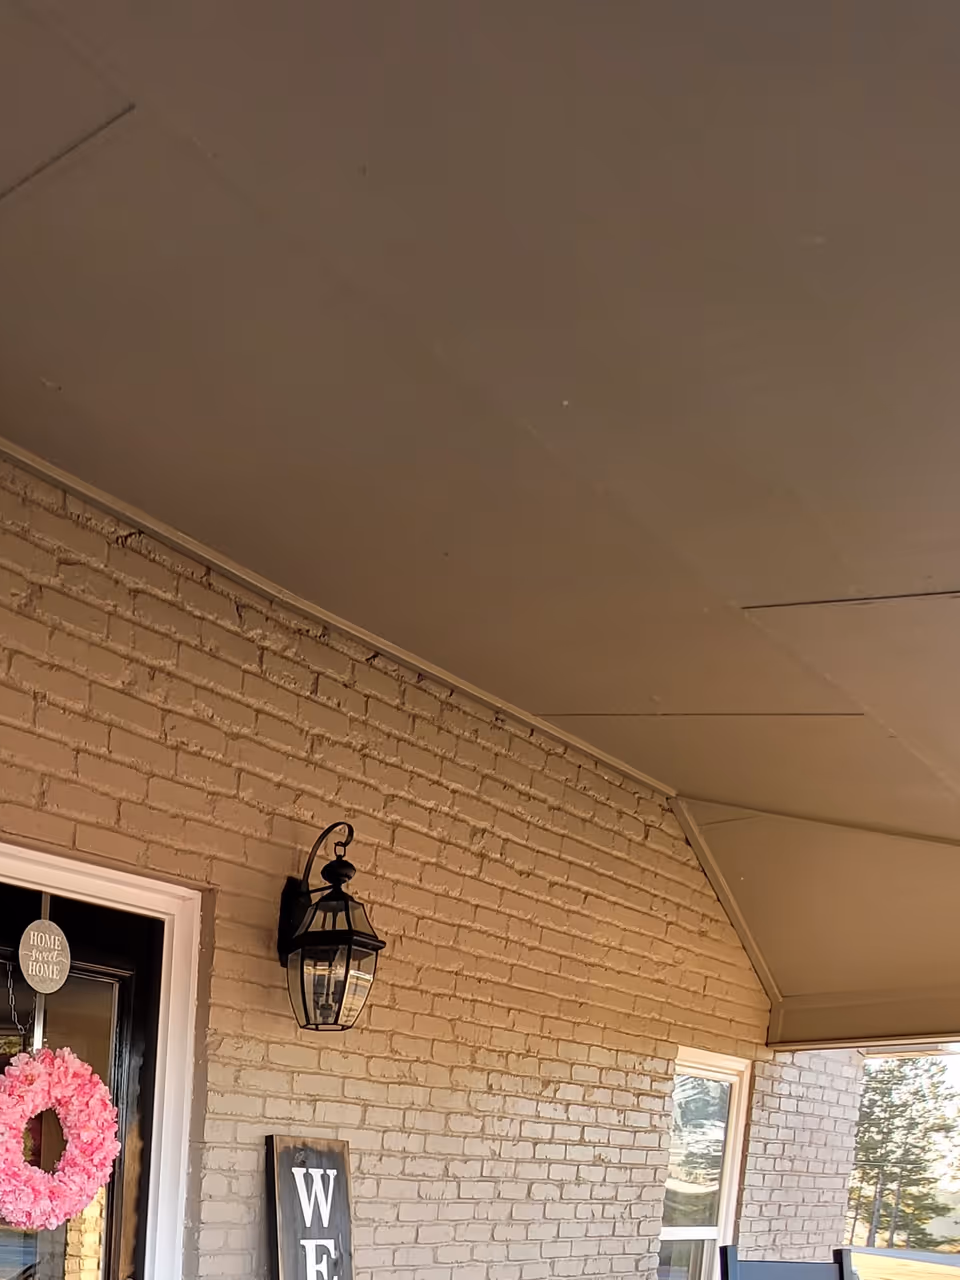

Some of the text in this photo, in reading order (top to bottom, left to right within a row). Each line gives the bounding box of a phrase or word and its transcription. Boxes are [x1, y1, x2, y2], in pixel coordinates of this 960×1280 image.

[30, 931, 62, 950] HOME
[24, 948, 66, 962] sweet
[28, 961, 61, 980] HOME
